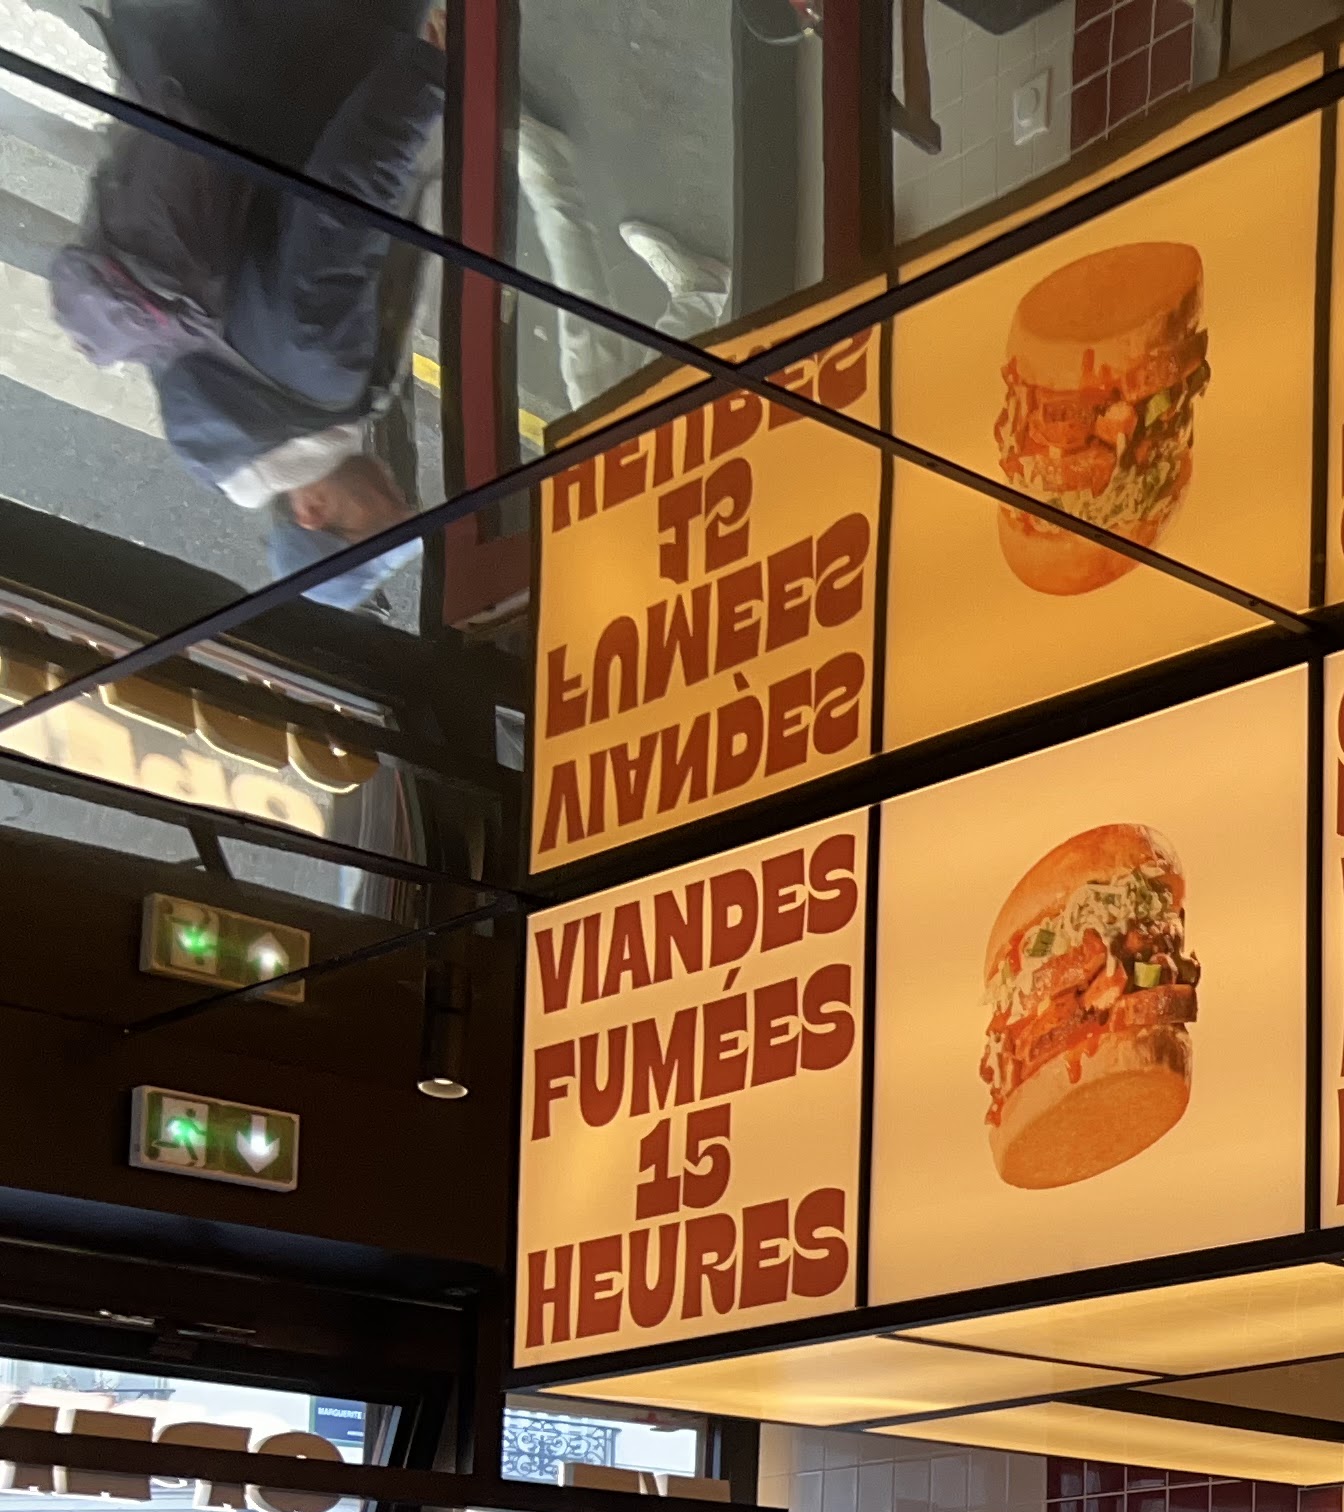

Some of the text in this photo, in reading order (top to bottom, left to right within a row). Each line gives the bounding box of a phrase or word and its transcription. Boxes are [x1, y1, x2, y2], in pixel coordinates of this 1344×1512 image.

[535, 834, 858, 1015] VIANDES
[531, 963, 855, 1141] FUMÉES
[635, 1102, 731, 1221] 15
[525, 1188, 849, 1349] HEURES
